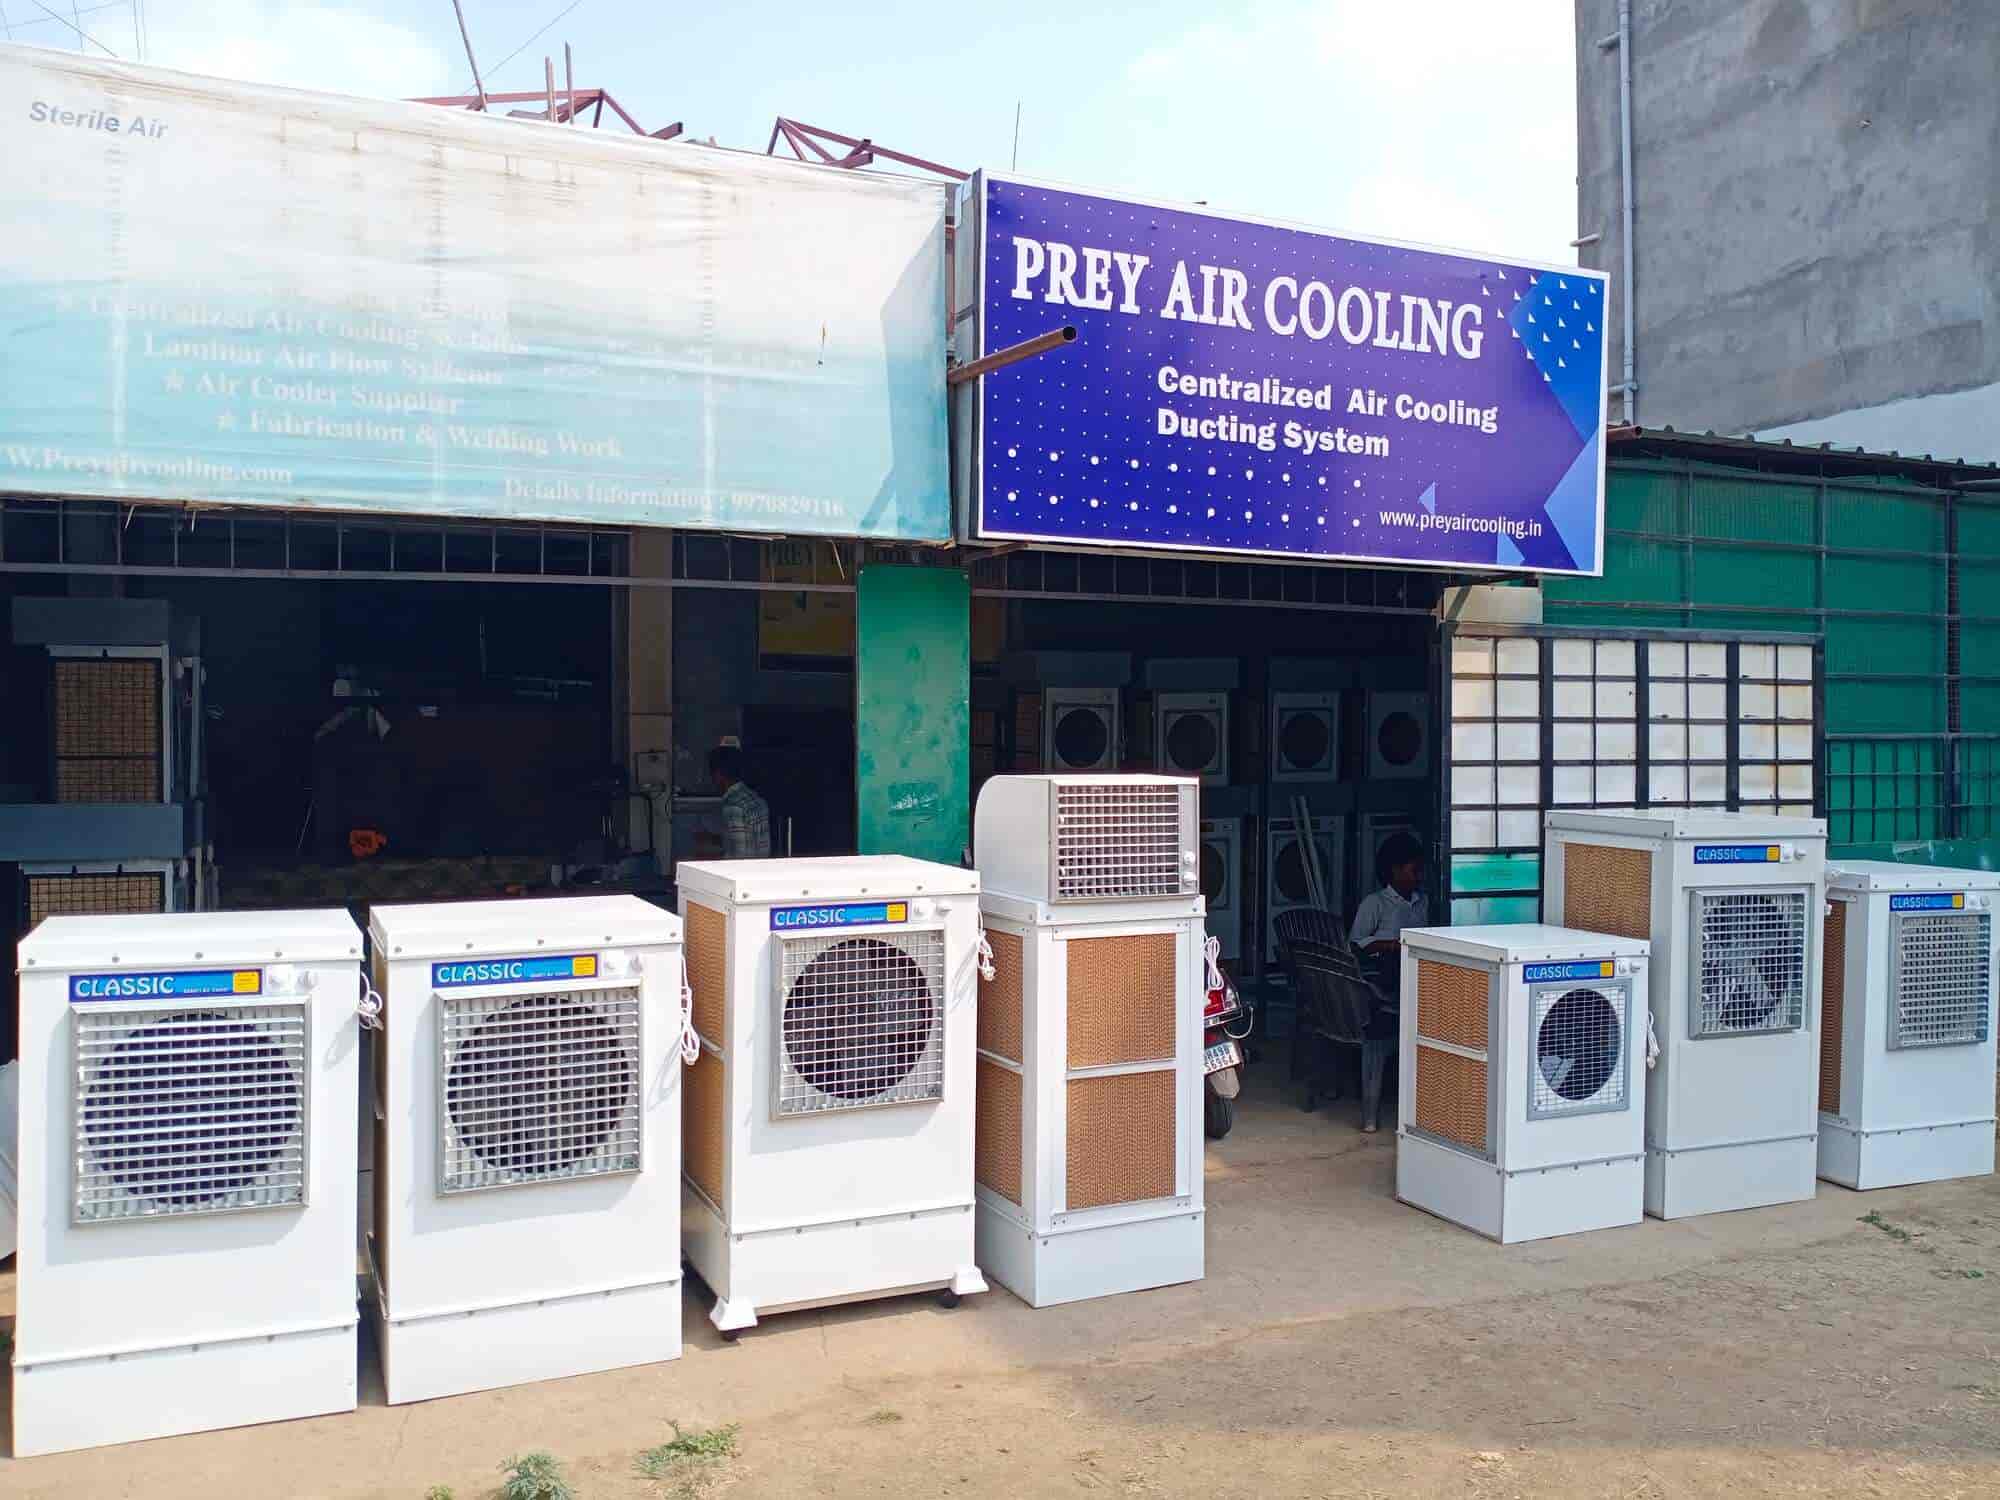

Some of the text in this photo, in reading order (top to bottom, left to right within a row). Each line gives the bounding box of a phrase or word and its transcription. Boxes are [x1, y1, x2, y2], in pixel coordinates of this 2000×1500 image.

[29, 101, 169, 138] Sterile Air
[1011, 236, 1484, 360] PREY AIR COOLING
[275, 344, 315, 370] Air
[198, 371, 241, 394] Air
[250, 374, 338, 402] Cooler
[1158, 366, 1499, 434] Centralized Air Cooling
[250, 408, 406, 442] Fabrication
[448, 424, 548, 457] Welding
[558, 430, 625, 458] Work
[1158, 408, 1390, 458] Ducting System
[1379, 508, 1543, 539] www.preyaircooling.in
[1696, 848, 1742, 861] CLASSIC
[1892, 896, 1931, 909] CLASSIC
[774, 908, 846, 926] CLASSIC
[437, 962, 524, 983] CLASSIC
[1525, 965, 1574, 979] CLASSIC
[74, 976, 176, 998] CLASSIC
